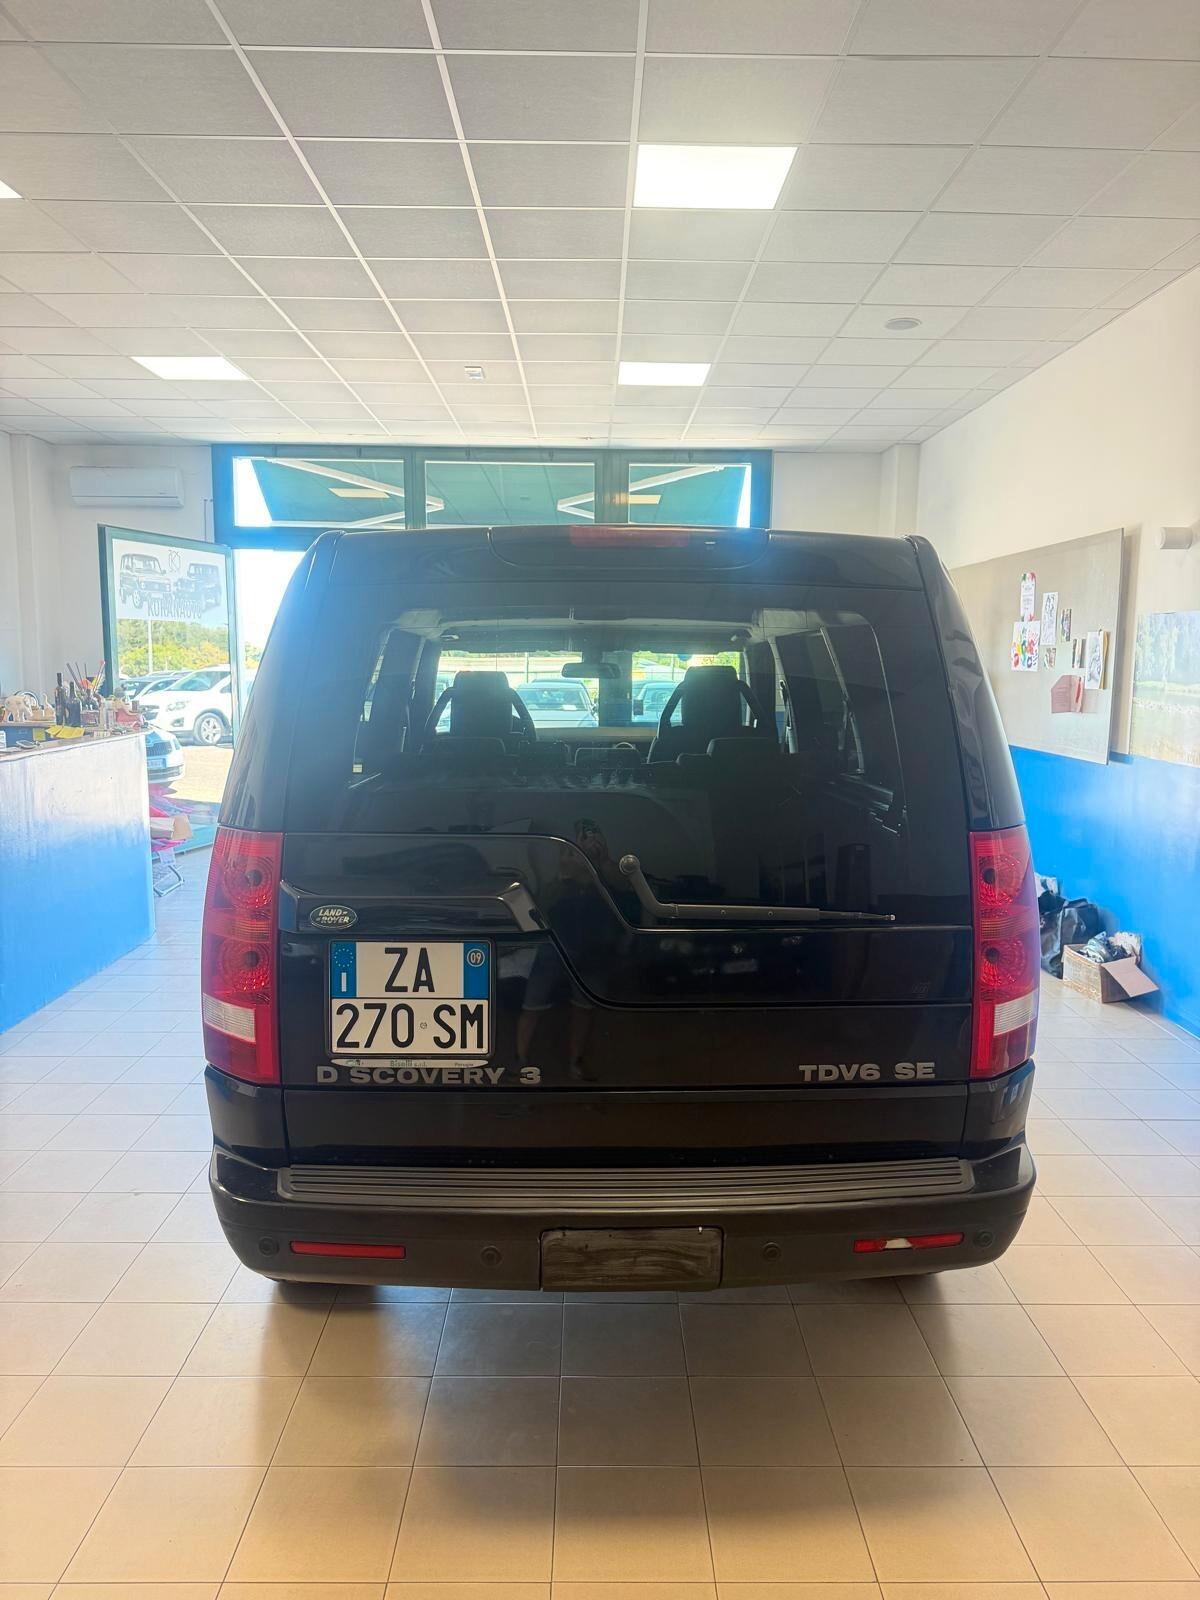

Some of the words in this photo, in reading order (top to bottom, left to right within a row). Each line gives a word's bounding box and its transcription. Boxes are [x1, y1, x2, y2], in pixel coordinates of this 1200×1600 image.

[469, 952, 482, 964] 09
[384, 947, 435, 993] ZA
[341, 972, 347, 992] I
[336, 1003, 415, 1049] 270
[433, 1004, 485, 1049] SM
[519, 1067, 541, 1084] 3
[799, 1063, 881, 1082] TDV6
[894, 1062, 936, 1080] SE
